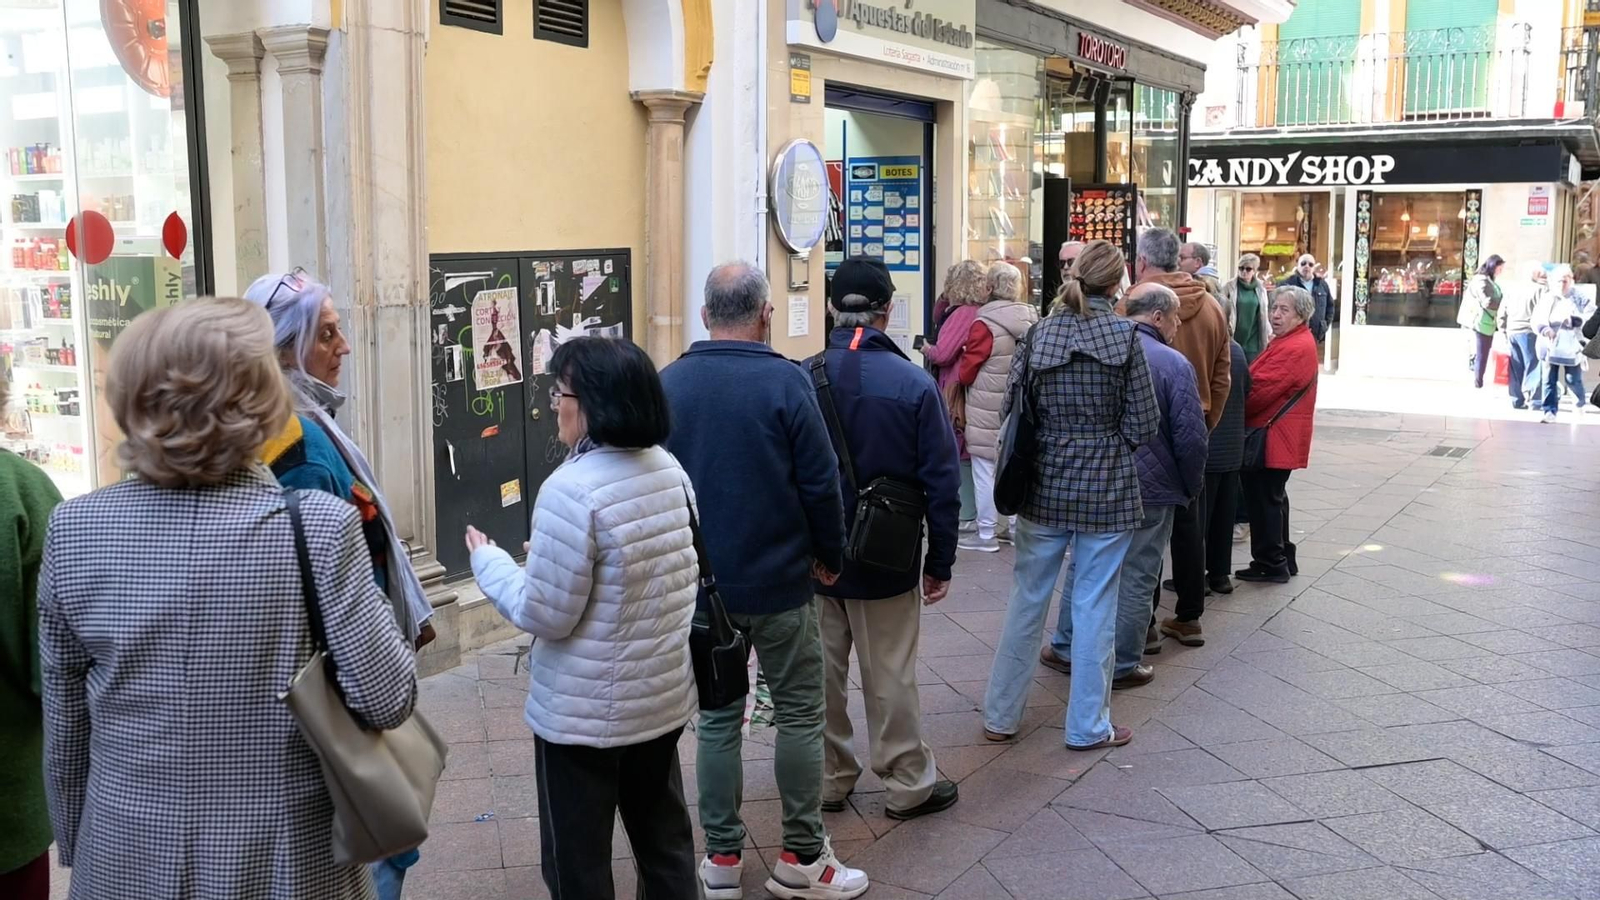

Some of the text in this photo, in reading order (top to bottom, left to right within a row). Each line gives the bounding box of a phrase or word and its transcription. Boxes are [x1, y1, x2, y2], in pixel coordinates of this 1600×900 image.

[848, 0, 973, 49] Apuestas del Estado
[1079, 32, 1126, 69] TOROTORO
[885, 168, 913, 176] BOTES
[1188, 150, 1396, 186] CANDY SHOP
[476, 307, 496, 316] CORT
